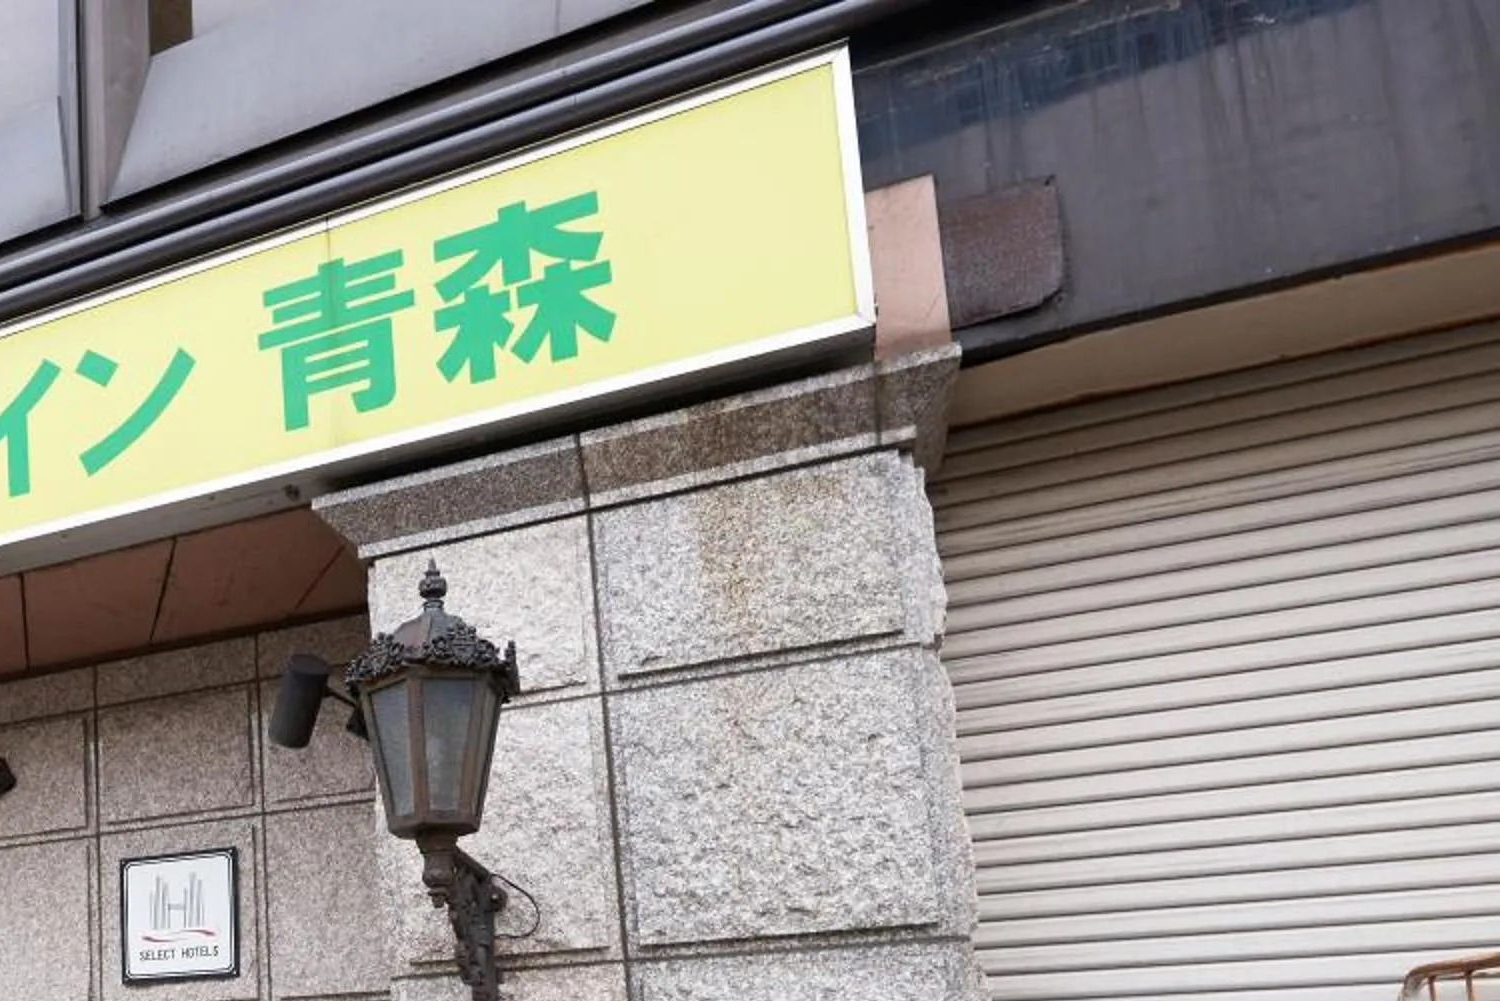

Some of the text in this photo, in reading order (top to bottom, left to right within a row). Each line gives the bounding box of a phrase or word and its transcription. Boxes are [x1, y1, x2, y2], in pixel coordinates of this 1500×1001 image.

[259, 191, 616, 430] 青森
[139, 945, 219, 961] SELECT HOTELS
